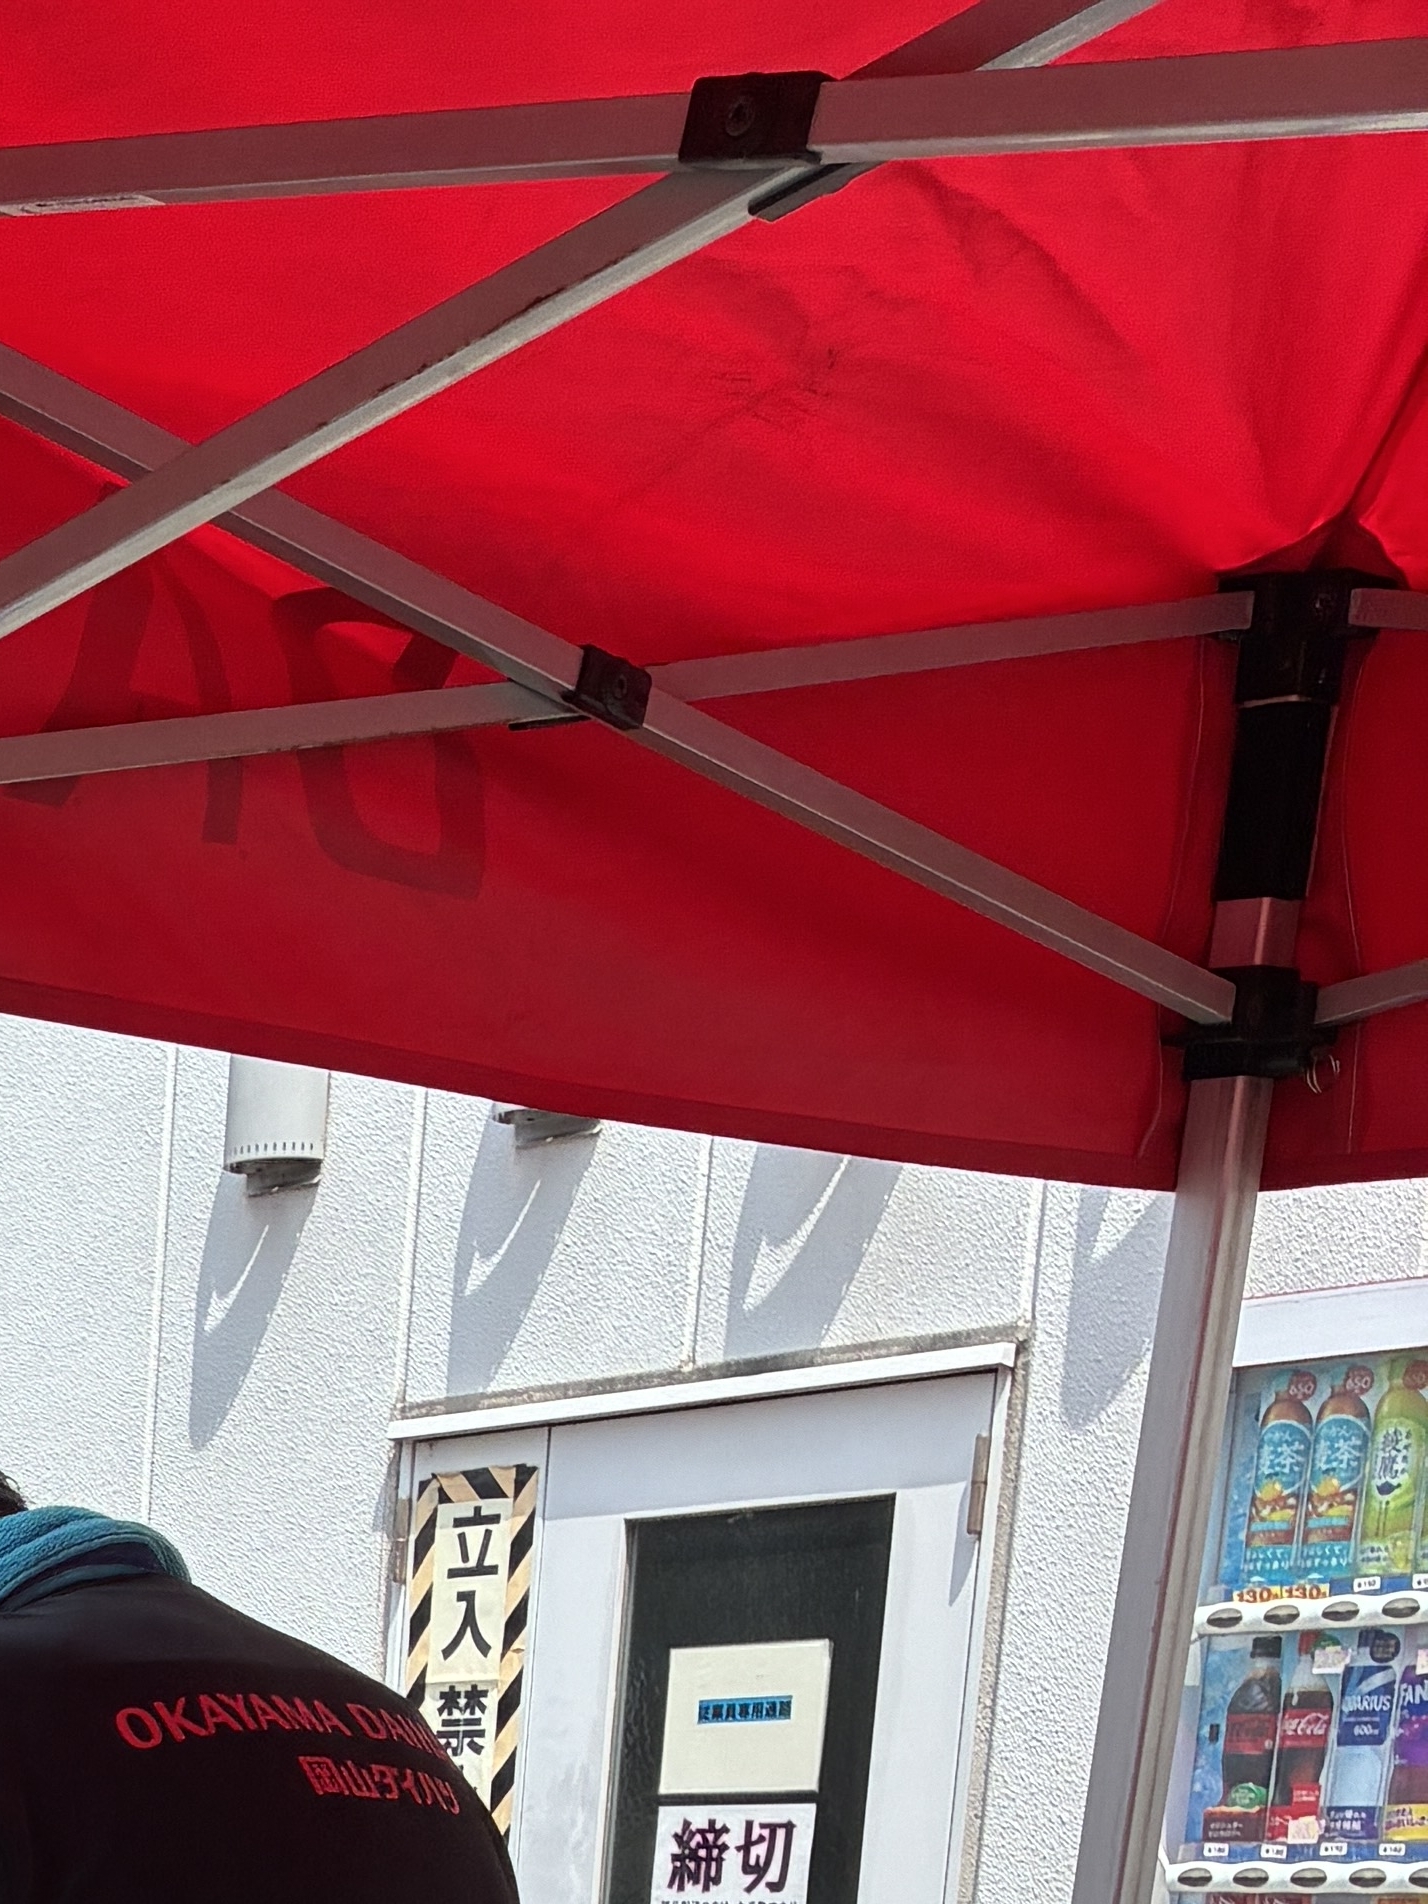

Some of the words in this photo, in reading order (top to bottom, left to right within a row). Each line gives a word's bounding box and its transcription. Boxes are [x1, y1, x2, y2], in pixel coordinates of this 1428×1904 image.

[436, 1504, 500, 1794] 立入禁
[114, 1691, 349, 1751] OKAYAMA
[297, 1755, 461, 1816] 岡山ダイハツ
[666, 1818, 796, 1895] 締切
